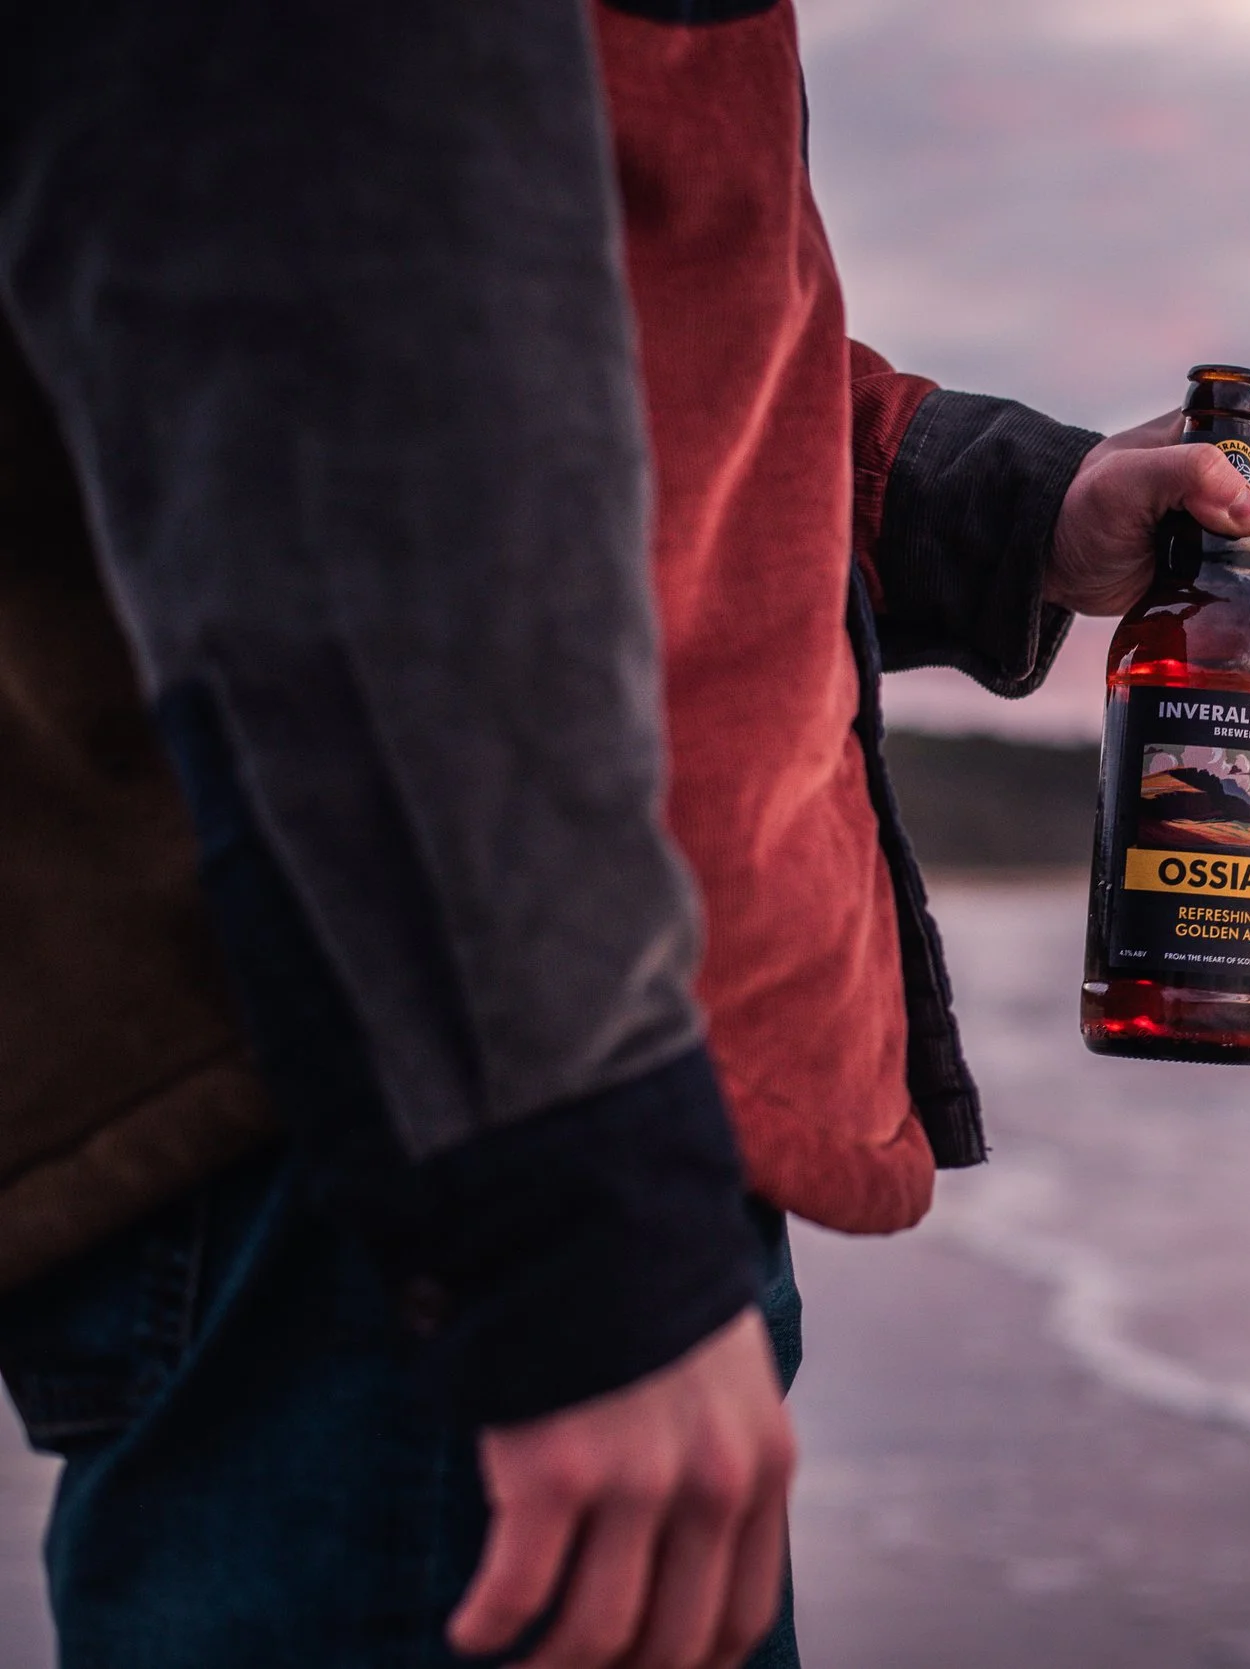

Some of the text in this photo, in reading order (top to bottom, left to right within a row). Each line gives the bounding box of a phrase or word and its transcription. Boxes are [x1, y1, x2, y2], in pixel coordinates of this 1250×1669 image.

[1175, 923, 1239, 940] GOLDEN
[1164, 952, 1186, 961] FROM
[1187, 953, 1202, 962] THE
[1203, 955, 1226, 964] HEART
[1226, 957, 1236, 965] OF
